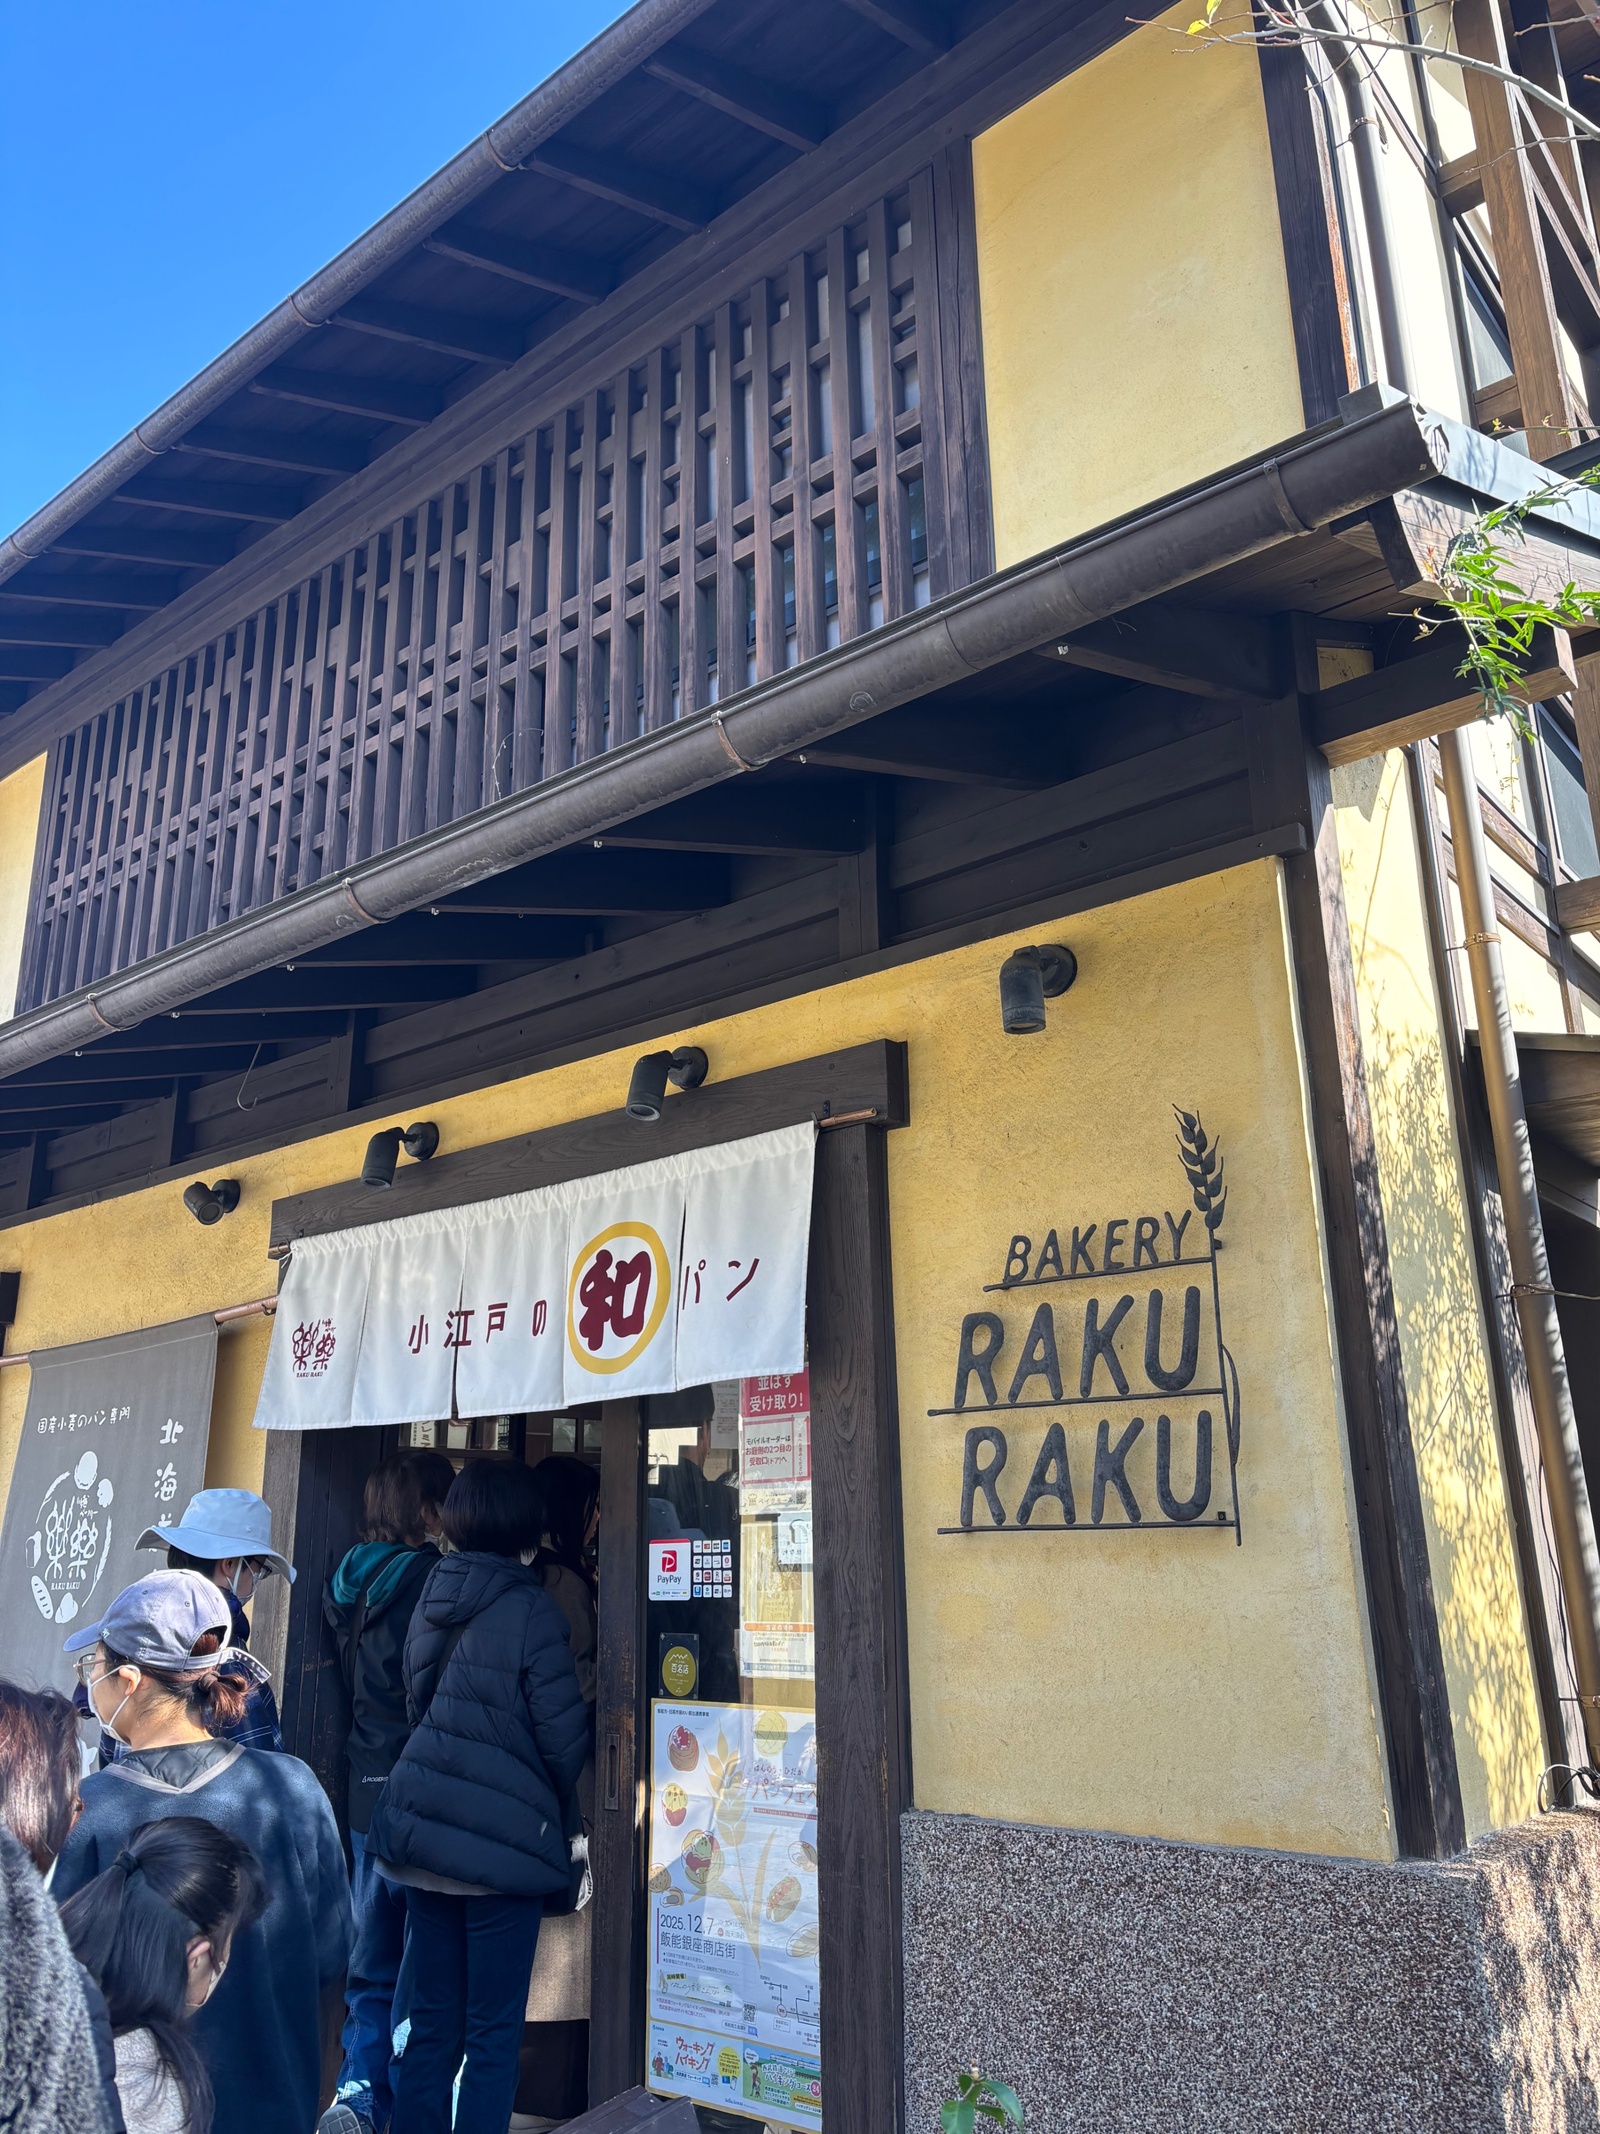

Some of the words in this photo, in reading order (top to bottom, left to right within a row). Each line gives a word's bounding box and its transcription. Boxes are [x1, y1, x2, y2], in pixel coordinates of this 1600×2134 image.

[1002, 1209, 1192, 1282] BAKERY
[954, 1286, 1200, 1408] RAKU
[746, 1435, 791, 1445] モバイルオーダーは
[961, 1410, 1212, 1526] RAKU
[51, 1582, 66, 1591] RAKU
[66, 1581, 81, 1590] RAKU
[657, 1575, 682, 1585] PayPay
[660, 1931, 736, 1960] 飯能銀座商店街
[675, 2036, 715, 2056] ウォーキング
[675, 2052, 712, 2071] ハイキング
